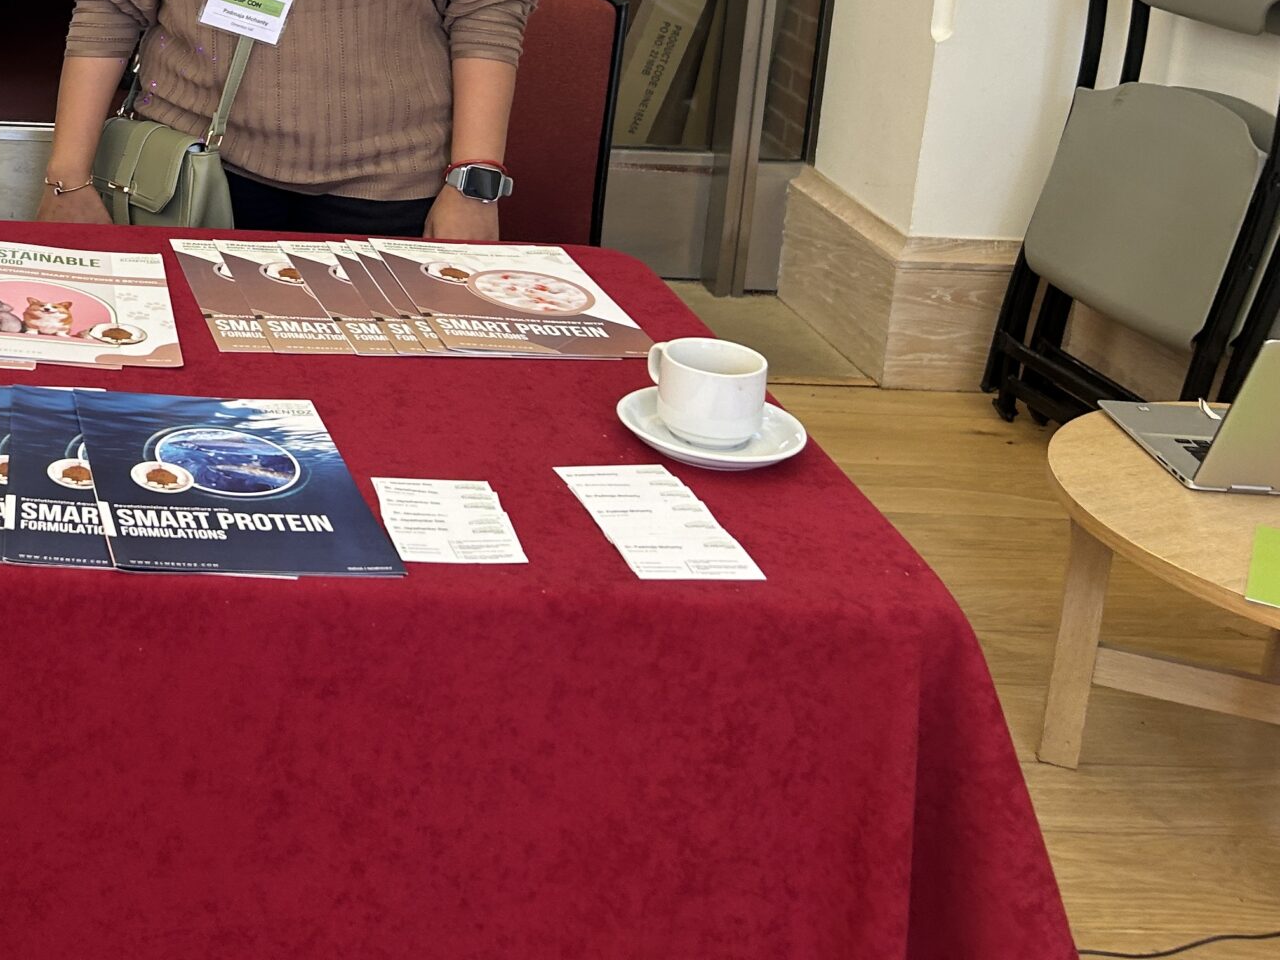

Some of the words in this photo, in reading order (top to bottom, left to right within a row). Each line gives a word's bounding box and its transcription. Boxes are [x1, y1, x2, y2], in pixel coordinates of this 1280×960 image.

[247, 0, 262, 8] CON
[660, 21, 671, 34] PO
[215, 320, 262, 331] SMA
[266, 320, 340, 334] SMART
[435, 318, 514, 334] SMART
[514, 323, 610, 338] PROTEIN
[220, 331, 266, 339] FORMUL
[443, 330, 528, 341] FORMULATIONS
[21, 501, 99, 524] SMAR
[21, 519, 105, 535] FORMULATIO
[116, 509, 209, 529] SMART
[217, 512, 334, 533] PROTEIN
[120, 526, 228, 540] FORMULATIONS
